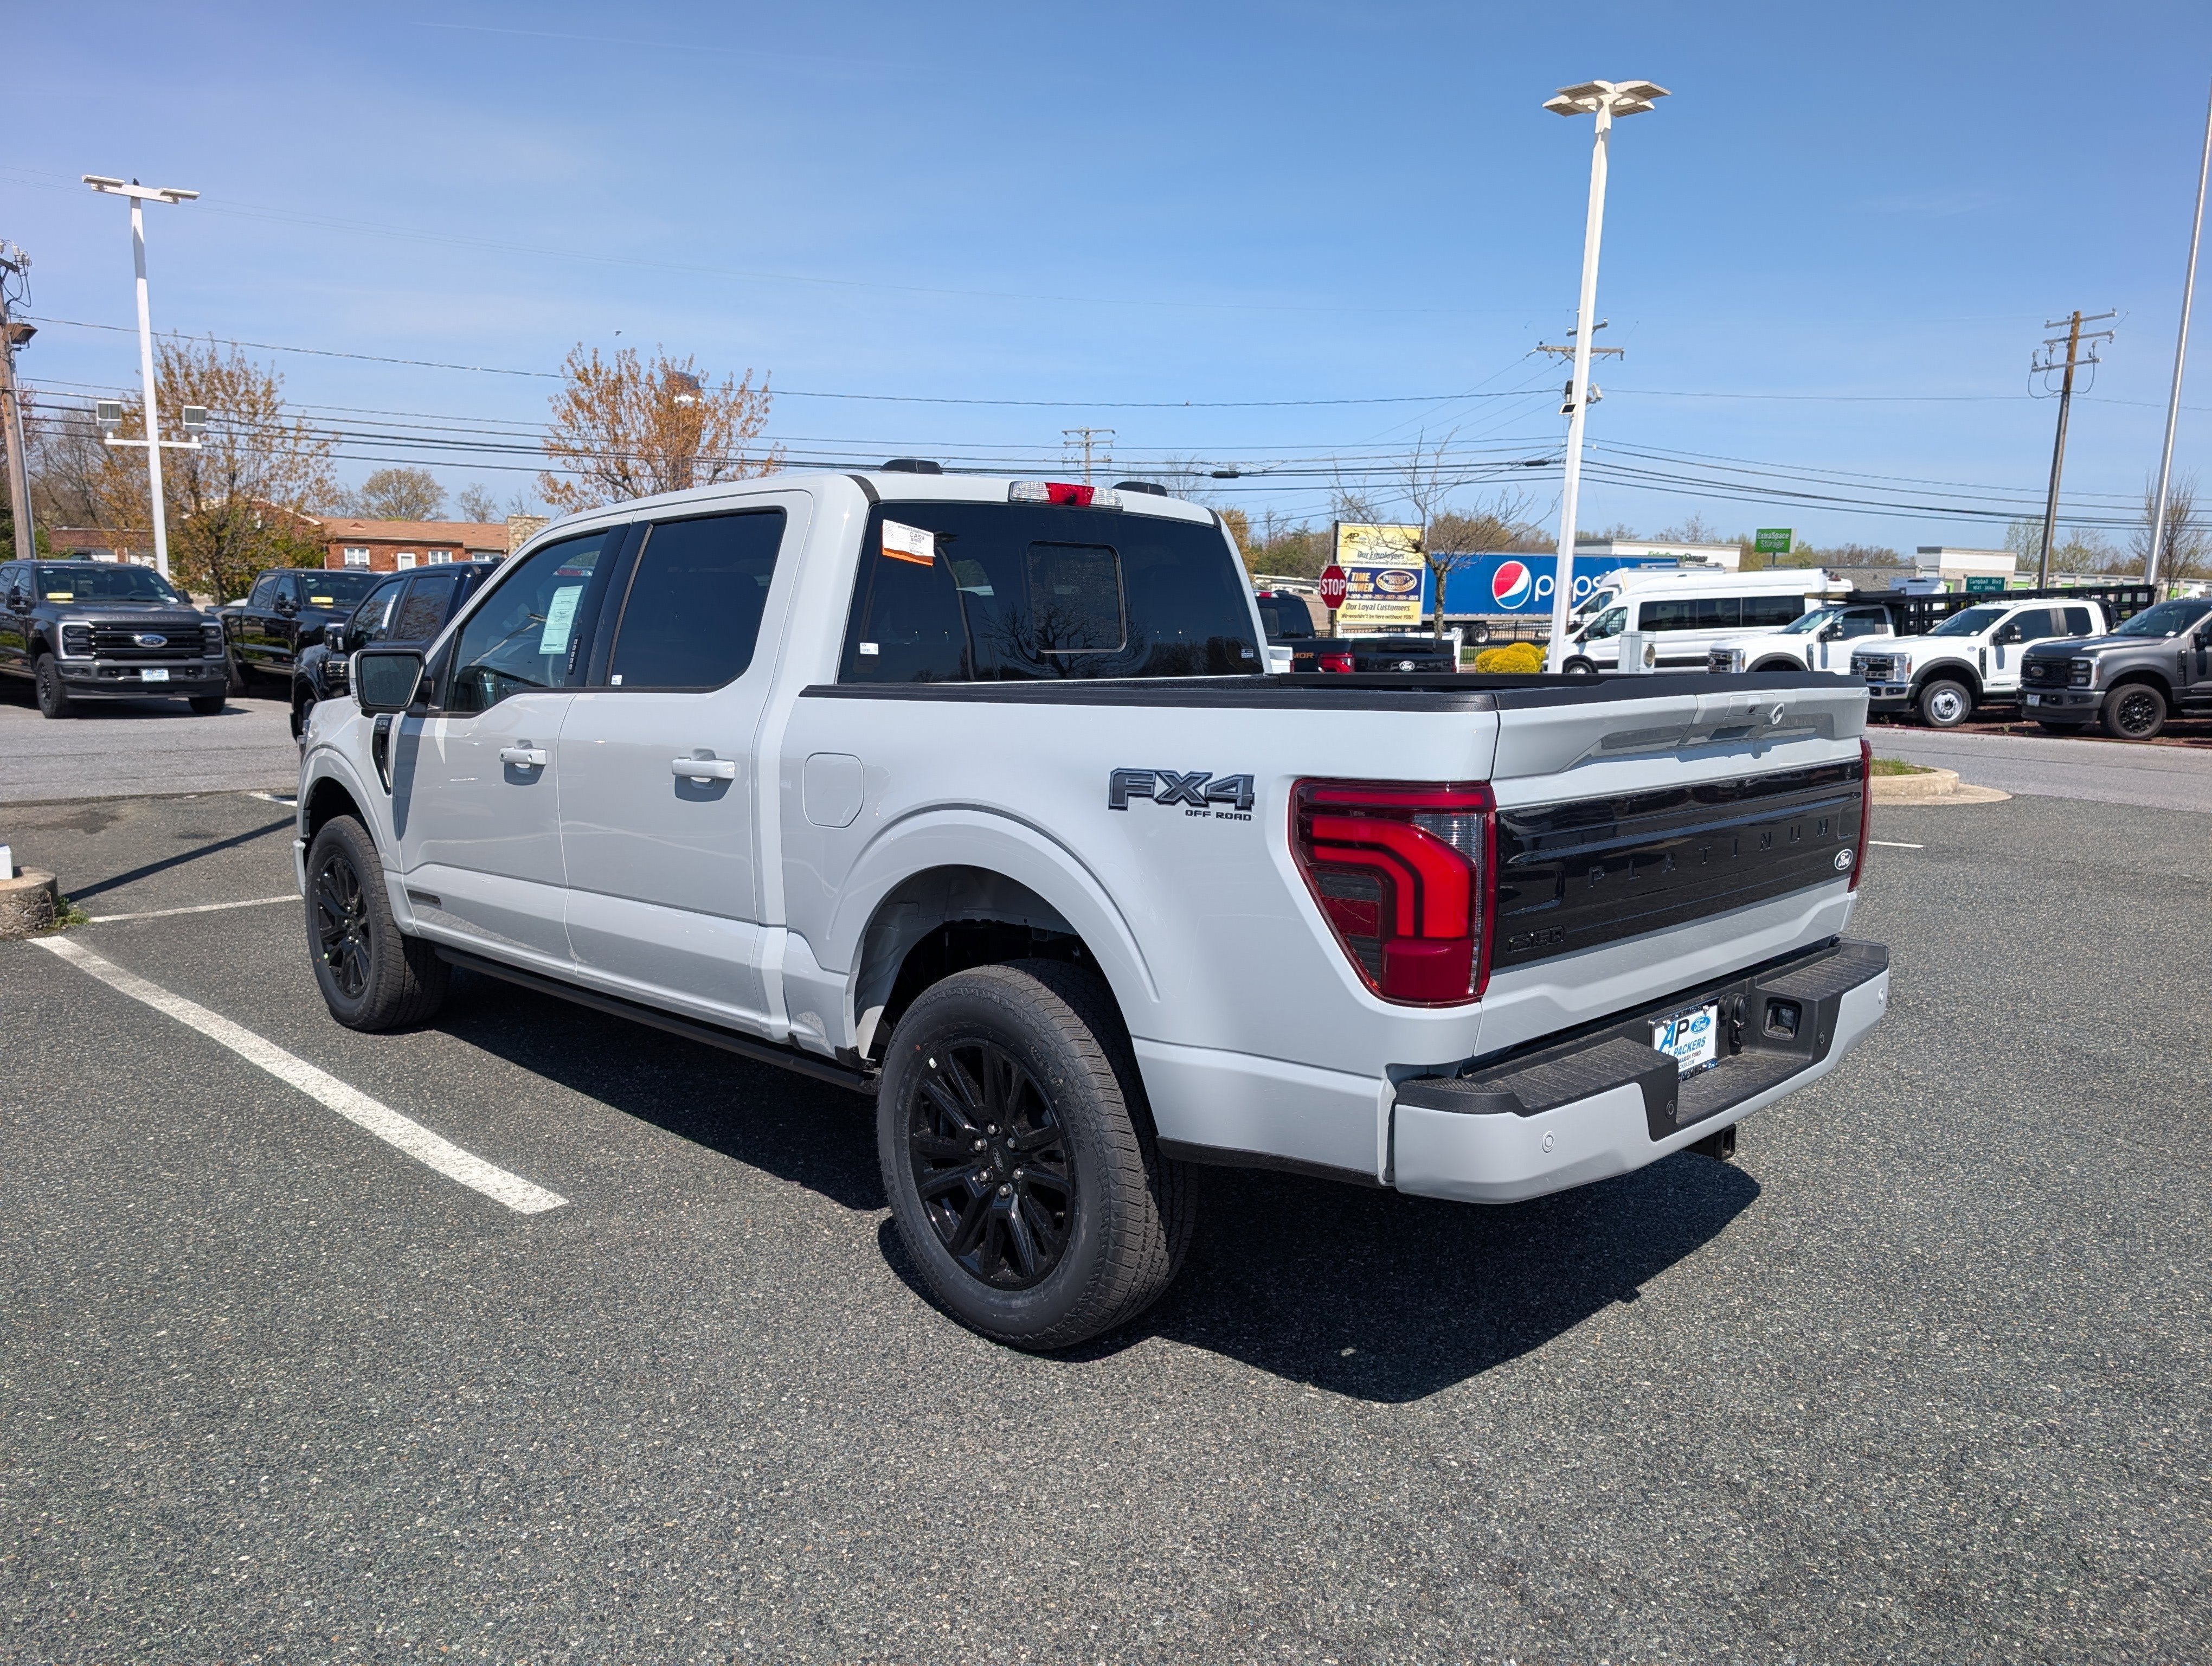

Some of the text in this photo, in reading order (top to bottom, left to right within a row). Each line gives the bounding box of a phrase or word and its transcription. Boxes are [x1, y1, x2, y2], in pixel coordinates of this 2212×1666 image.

[909, 532, 924, 540] CA59
[1760, 540, 1784, 549] Storage
[1351, 572, 1371, 582] TIME
[1321, 578, 1346, 595] STOP
[1346, 582, 1374, 593] INNER
[1345, 603, 1357, 611] Our
[1358, 603, 1376, 611] Loyal
[1108, 767, 1255, 812] FX4
[1185, 809, 1252, 822] OFF ROAD
[1587, 819, 1829, 889] PLATINUM
[1837, 851, 1851, 868] Ford
[1658, 1017, 1708, 1052] AP Ford
[1674, 1036, 1706, 1056] PACKERS
[1692, 1050, 1701, 1059] FORD
